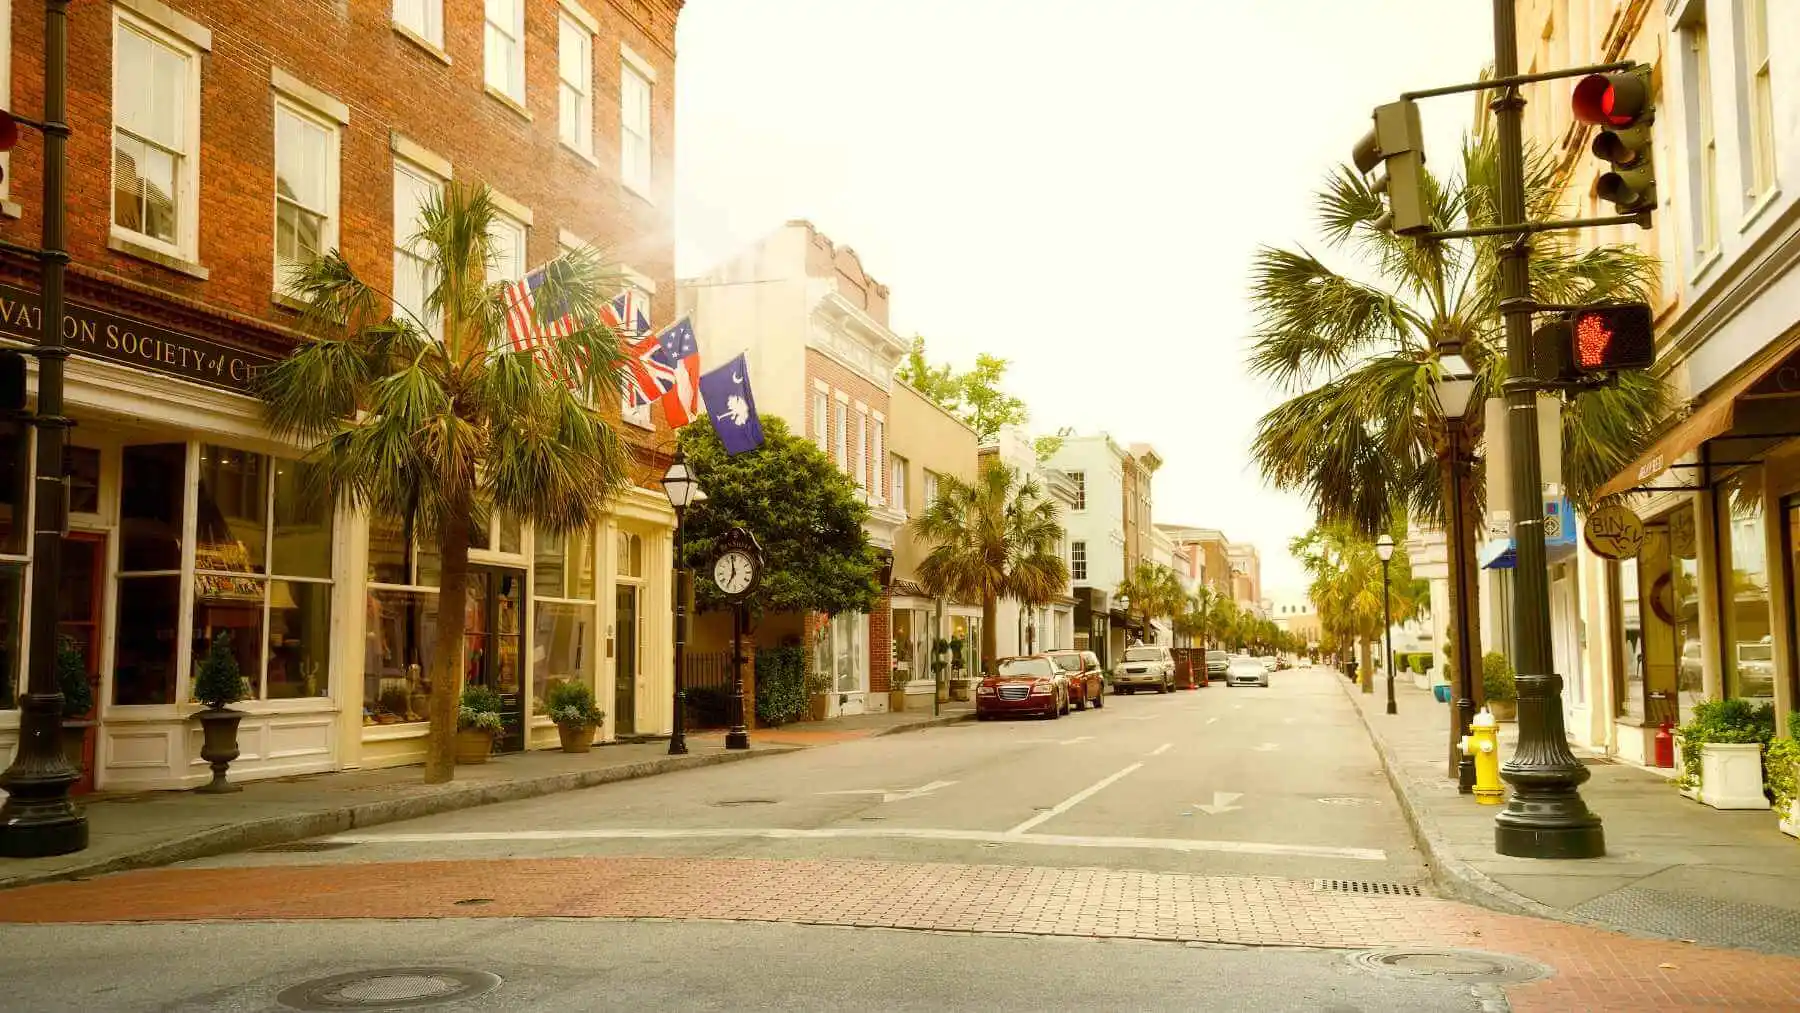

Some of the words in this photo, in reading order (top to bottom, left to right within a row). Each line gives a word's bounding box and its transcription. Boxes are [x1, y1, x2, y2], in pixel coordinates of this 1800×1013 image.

[0, 297, 97, 344] VATON
[106, 324, 207, 371] SOCIETY
[208, 354, 225, 377] of
